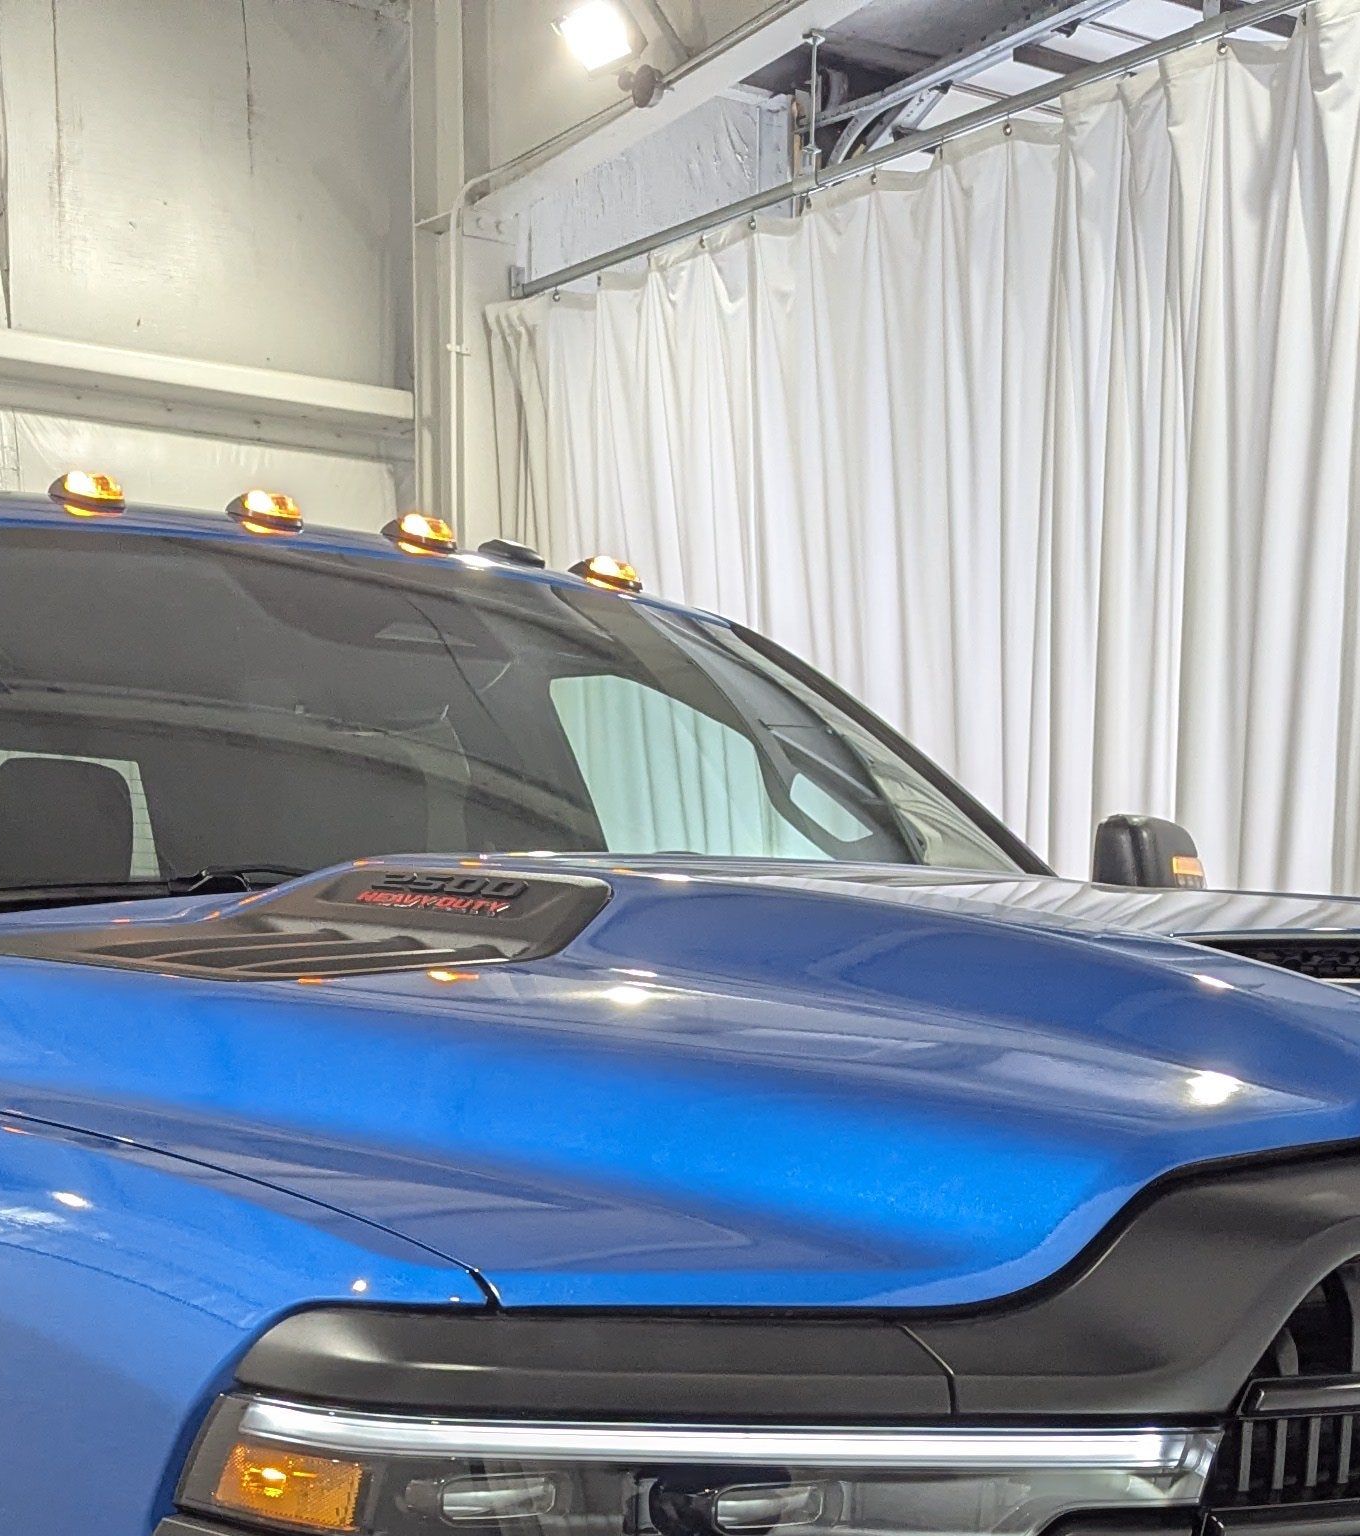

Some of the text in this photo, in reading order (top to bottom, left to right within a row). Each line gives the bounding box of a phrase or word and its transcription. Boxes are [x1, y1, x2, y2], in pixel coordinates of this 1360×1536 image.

[371, 872, 529, 899] 2500
[356, 890, 511, 917] HEAVY DUTY
